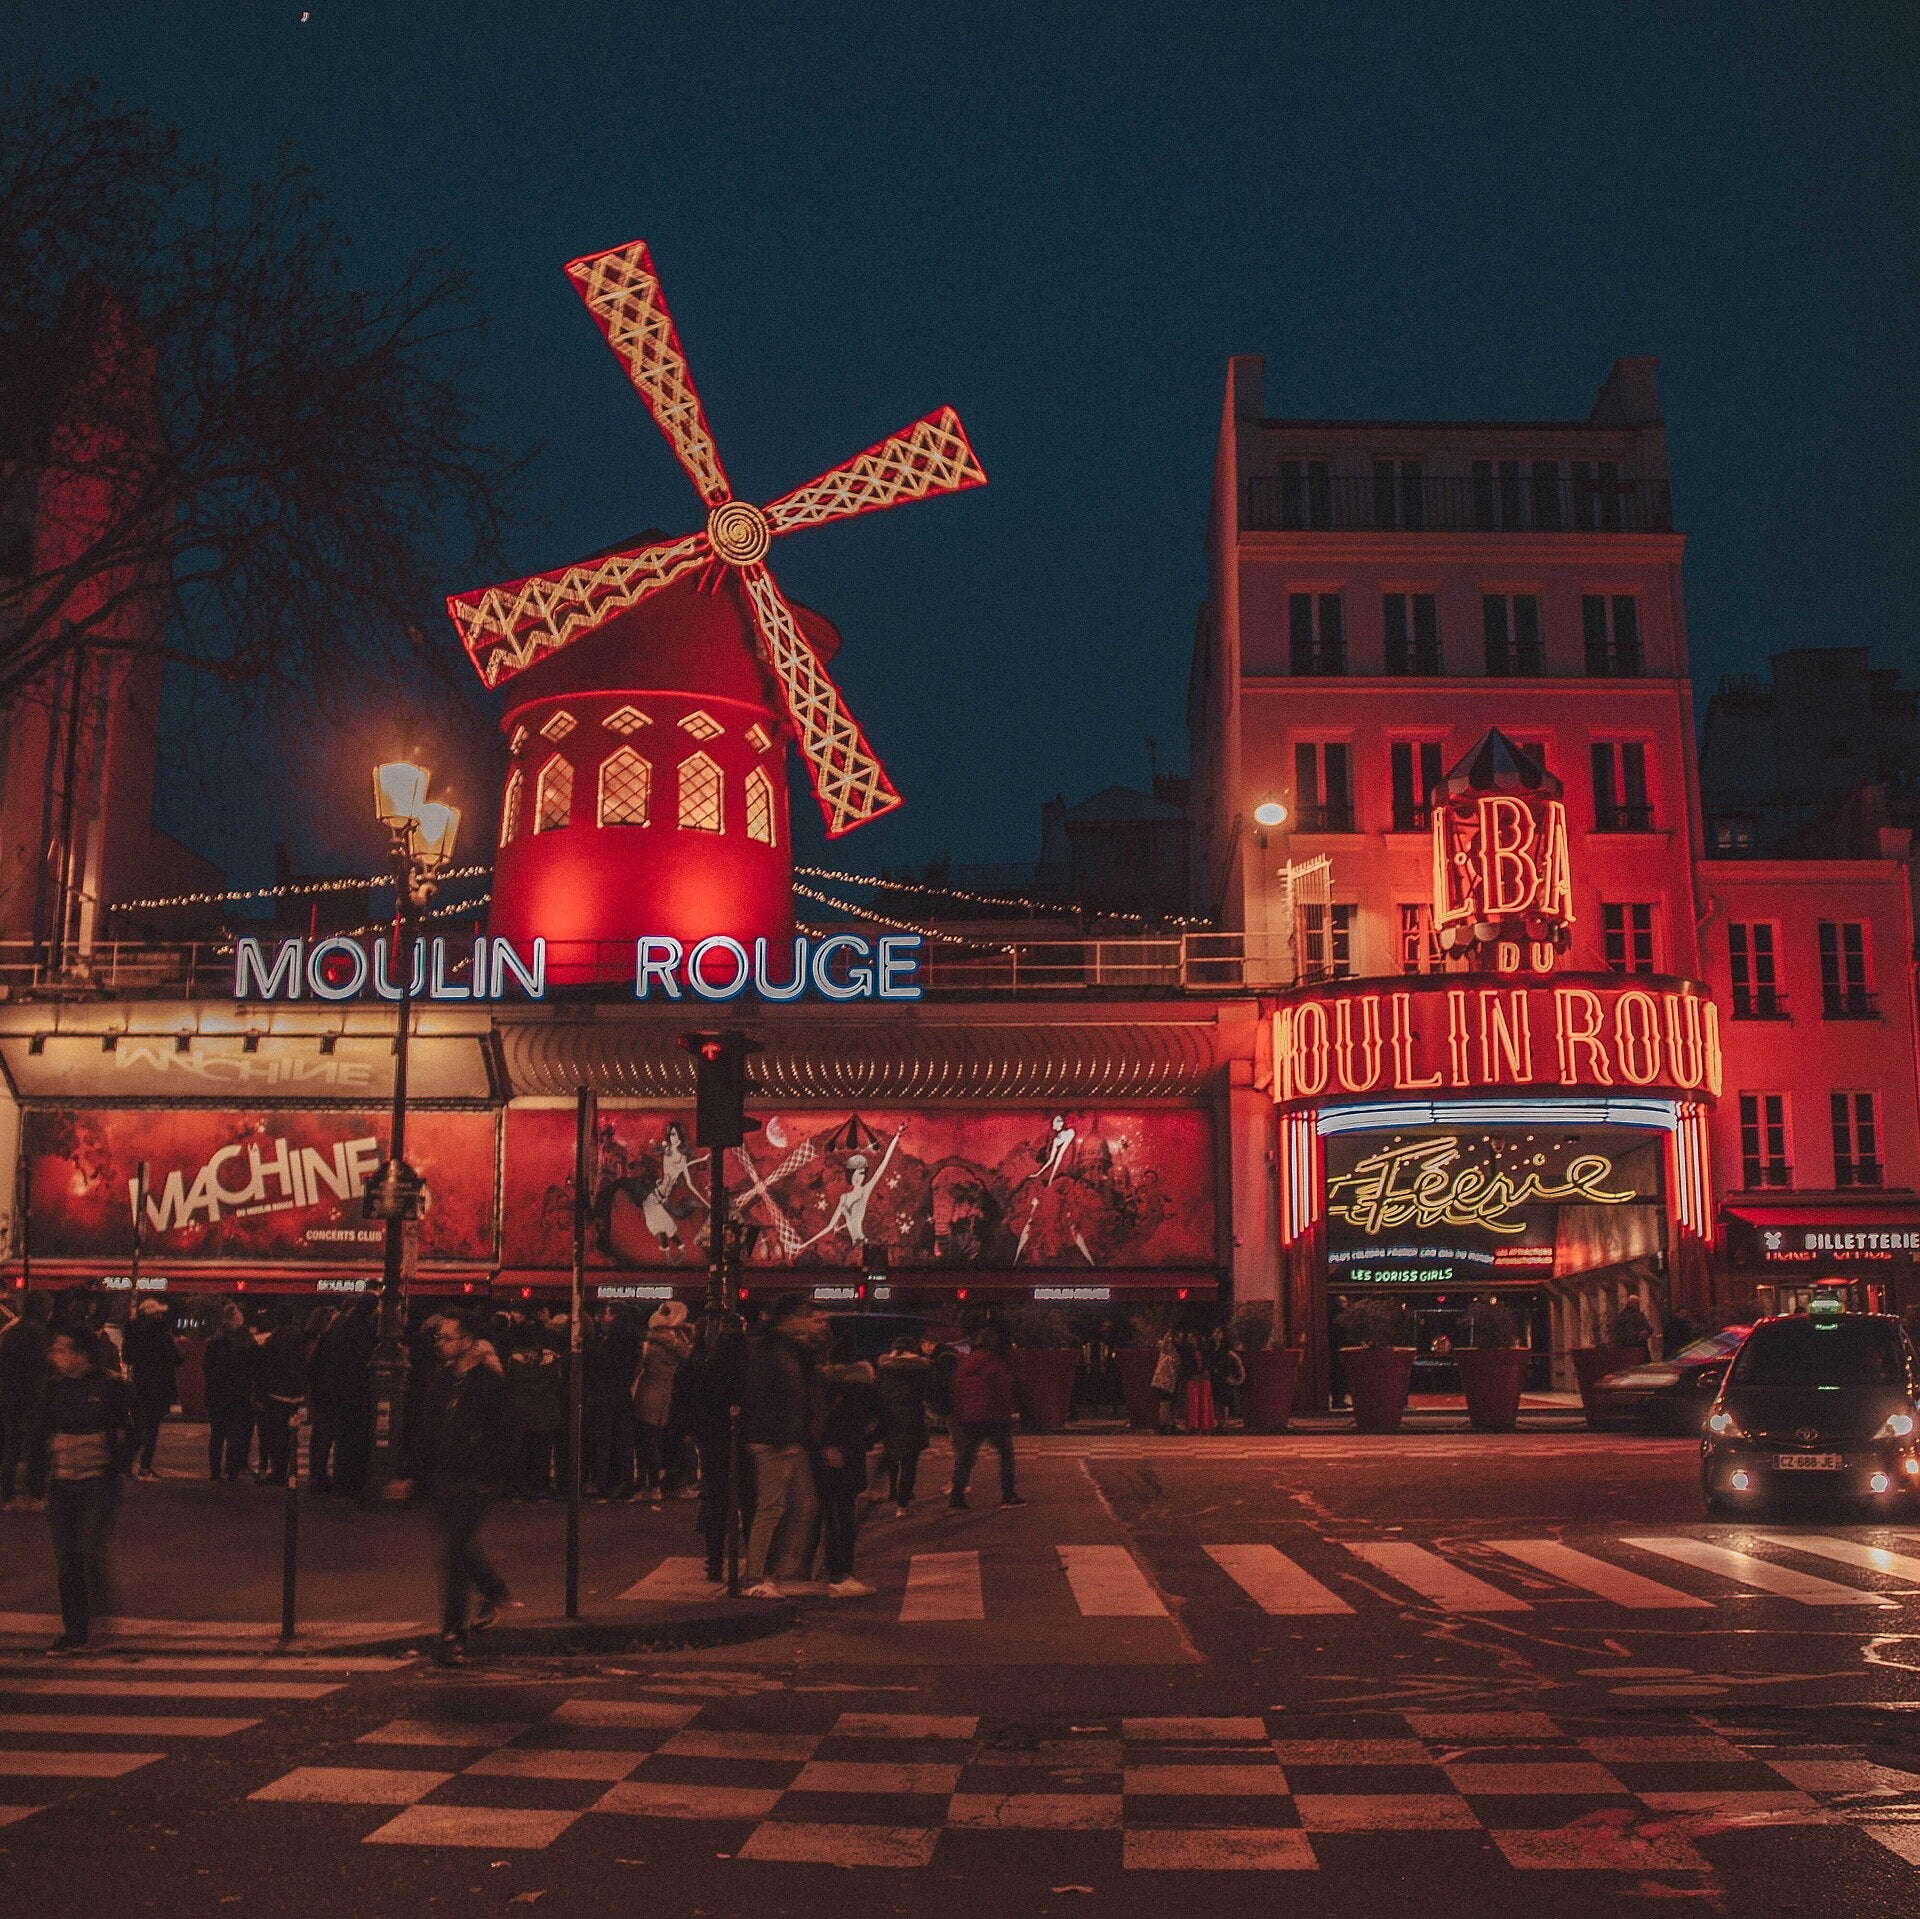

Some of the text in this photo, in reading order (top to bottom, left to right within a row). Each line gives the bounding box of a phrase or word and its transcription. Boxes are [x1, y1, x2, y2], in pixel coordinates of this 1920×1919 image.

[235, 935, 922, 999] MOULIN ROUGE
[1498, 941, 1554, 973] DU
[1273, 990, 1532, 1102] MOULIN
[128, 1136, 380, 1232] MACHINE
[305, 1229, 382, 1242] CONCERTS CLUB
[1804, 1233, 1920, 1250] BILLETTERIE
[1351, 1269, 1371, 1281] LES
[1419, 1268, 1453, 1281] GIRLS
